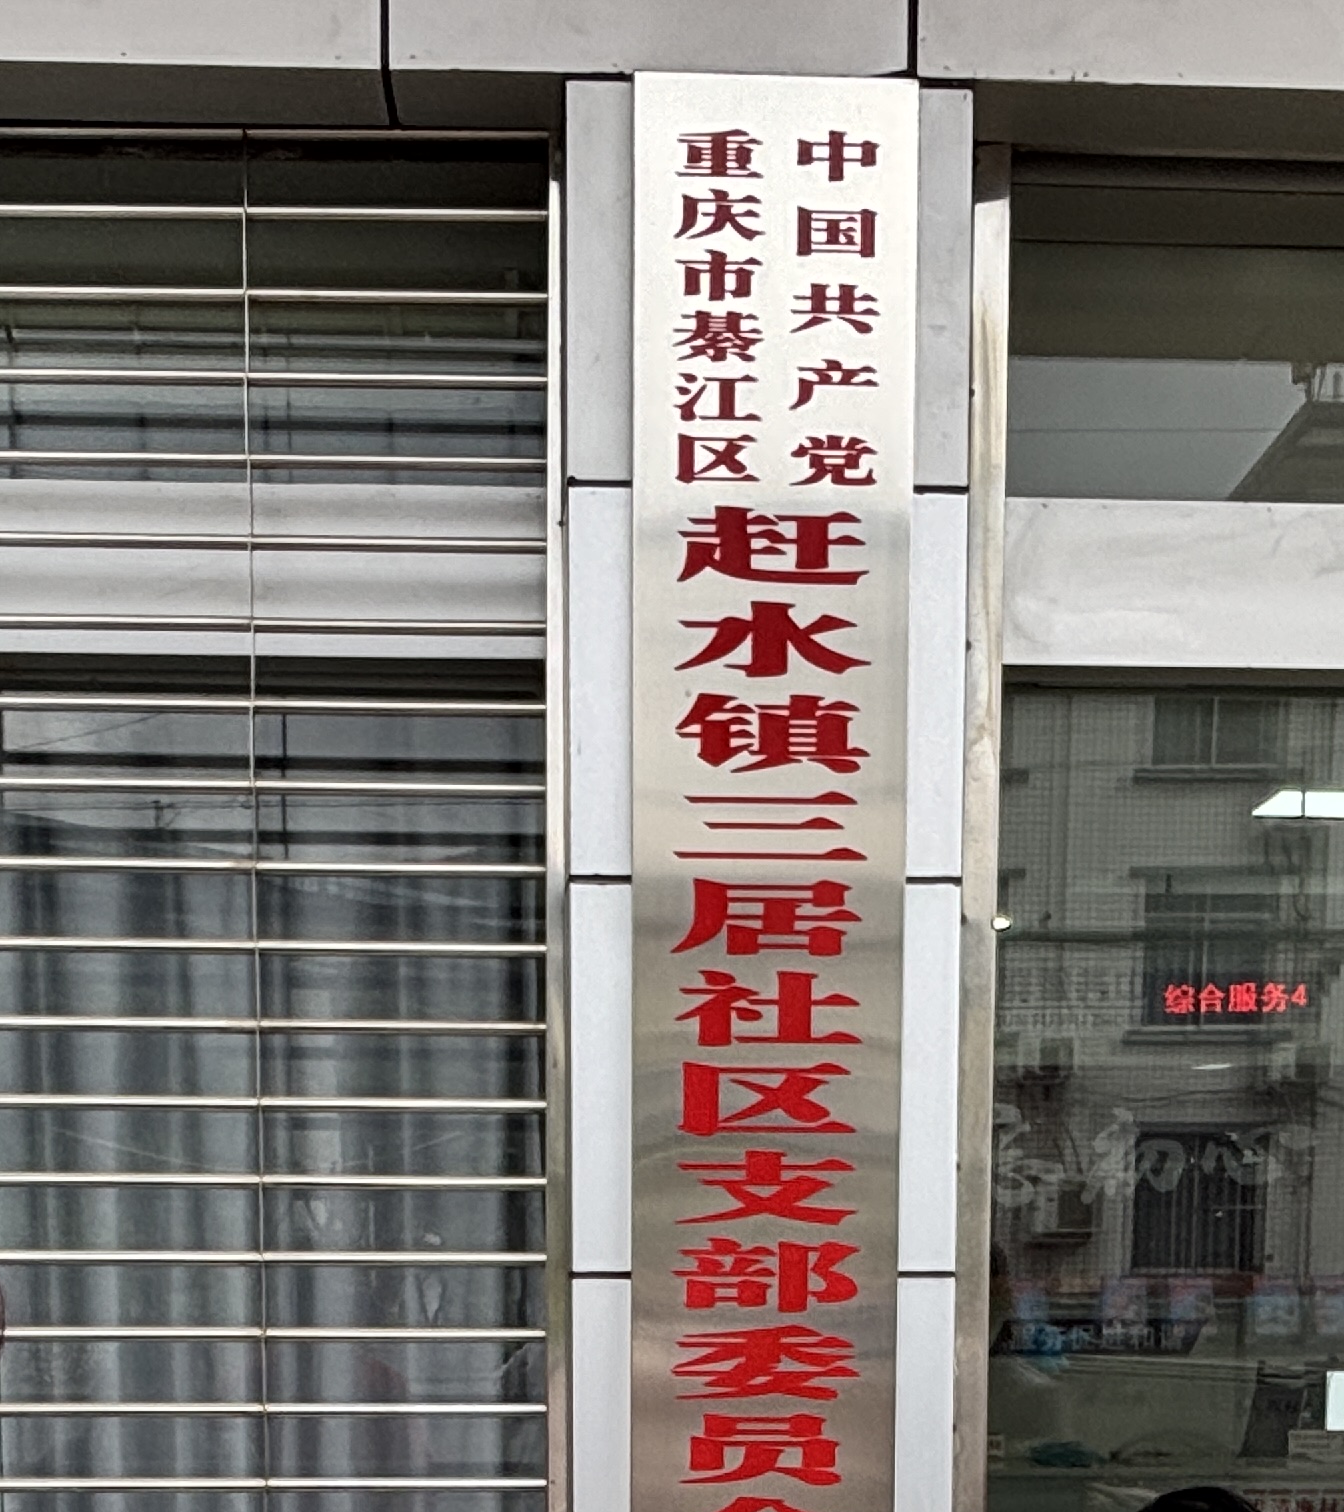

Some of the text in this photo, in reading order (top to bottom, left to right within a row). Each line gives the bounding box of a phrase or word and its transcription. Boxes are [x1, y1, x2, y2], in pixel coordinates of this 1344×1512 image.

[673, 128, 765, 485] 重庆市綦江区
[789, 130, 881, 487] 中国共产党
[1163, 981, 1308, 1014] 综合服务4
